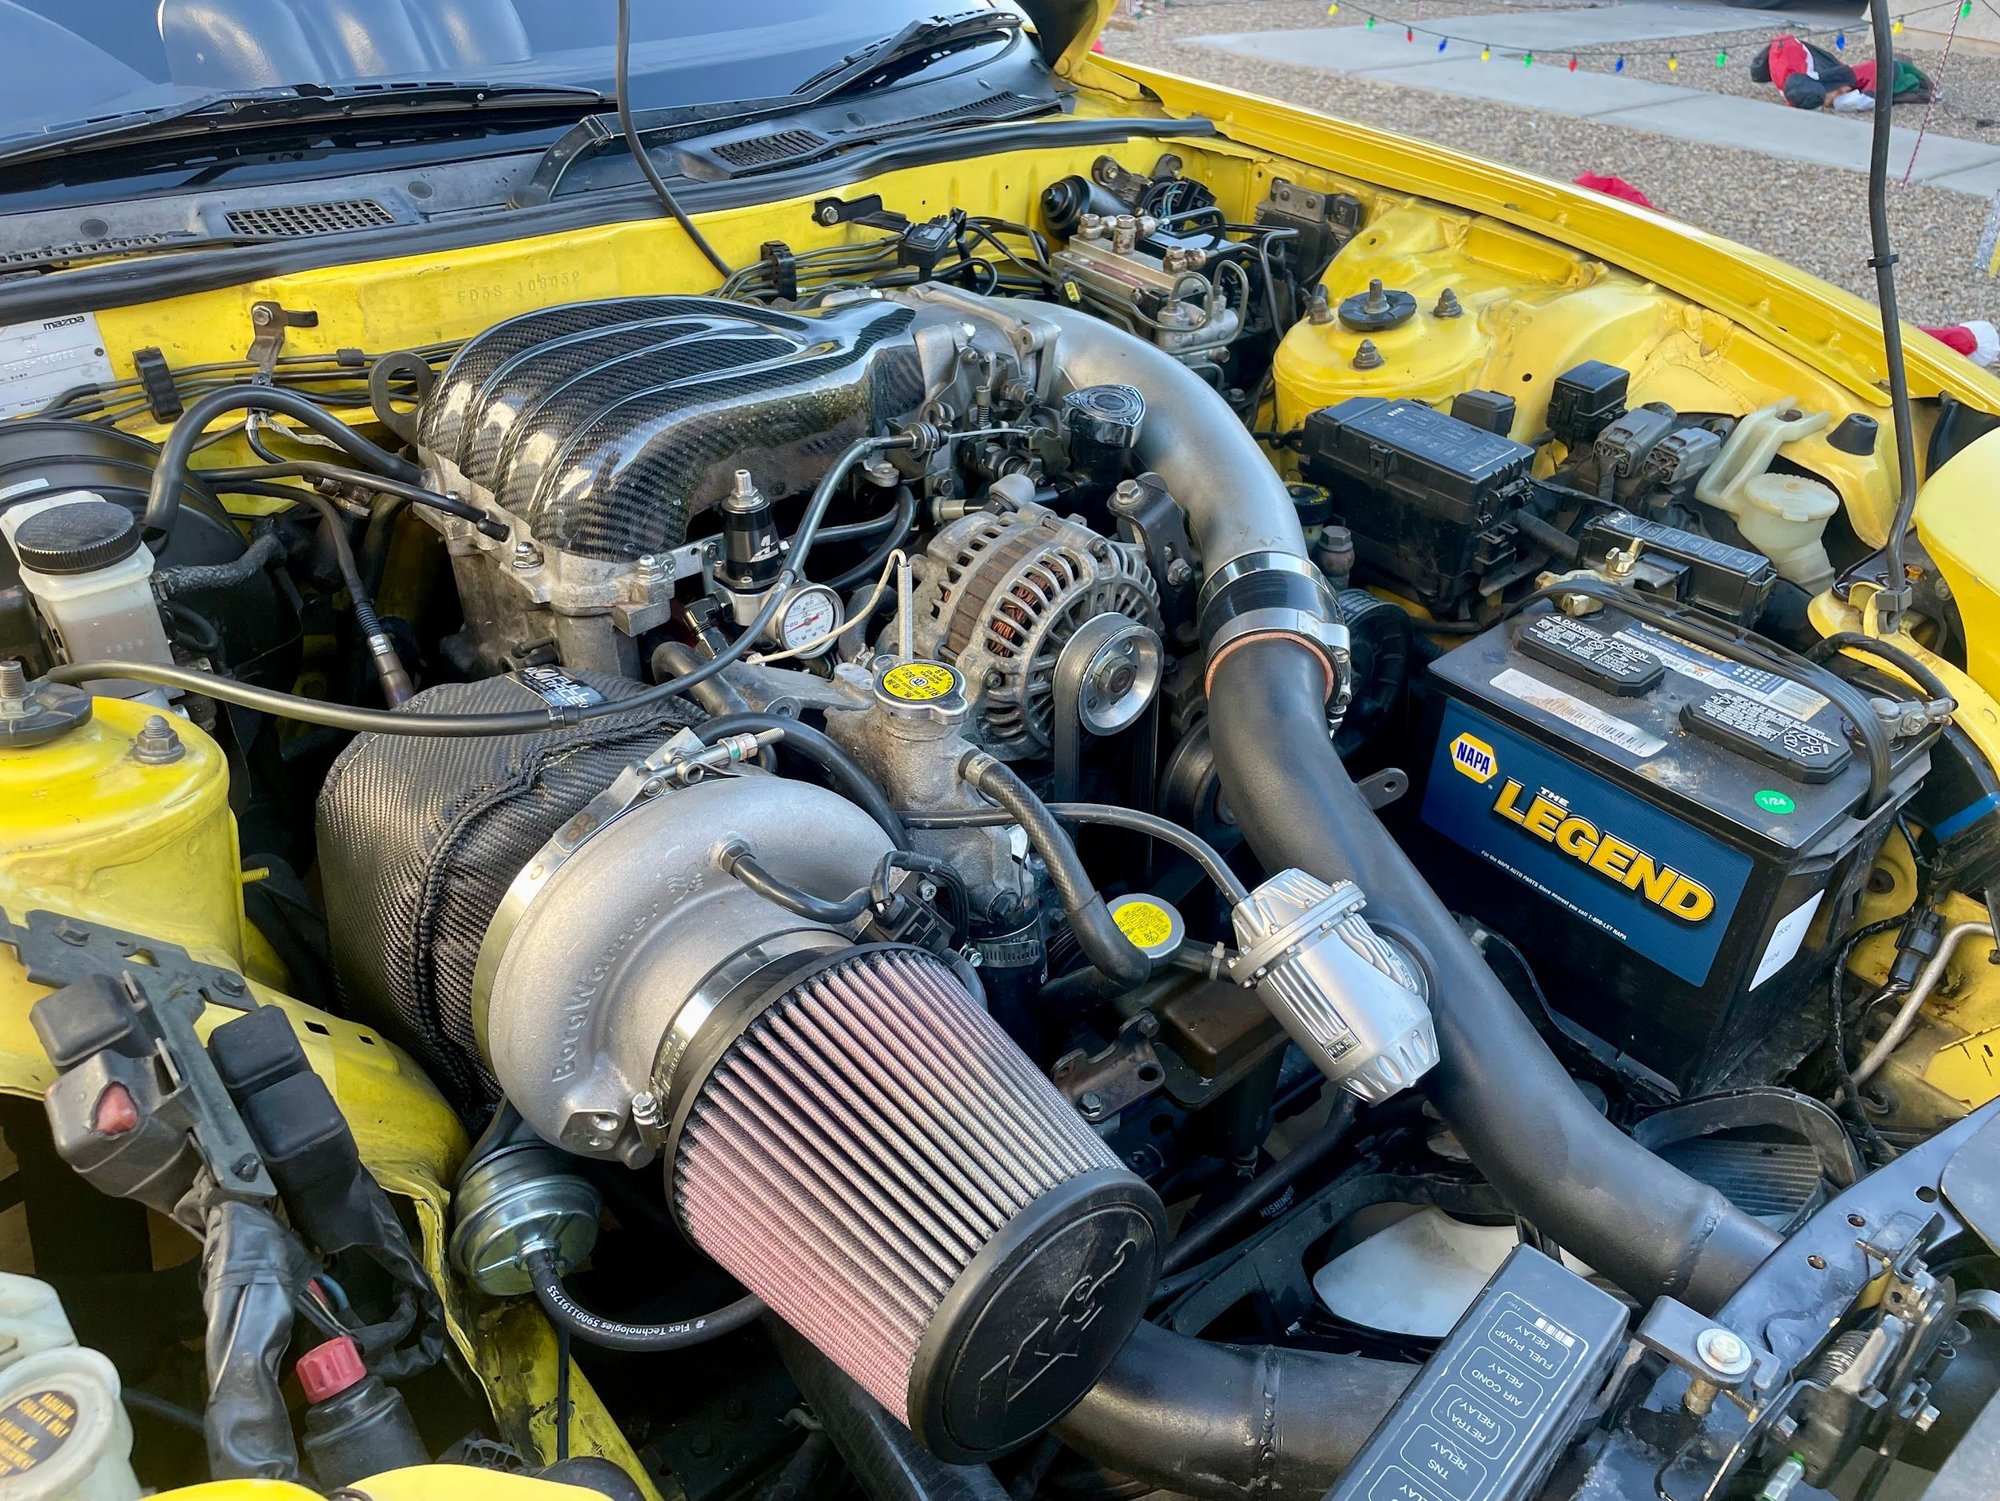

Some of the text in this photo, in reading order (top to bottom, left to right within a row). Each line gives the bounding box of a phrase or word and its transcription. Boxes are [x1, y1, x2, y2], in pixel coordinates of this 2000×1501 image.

[43, 315, 85, 330] mazda
[1561, 619, 1603, 640] DANGER
[1610, 641, 1649, 660] POISON
[1456, 741, 1490, 775] NAPA
[1540, 786, 1570, 807] THE
[1493, 777, 1716, 922] LEGEND
[1497, 859, 1510, 870] NAPA
[1509, 867, 1523, 878] AUTO
[1523, 874, 1538, 888] PARTS
[1538, 884, 1551, 895] Store
[1551, 892, 1570, 905] nearest
[1613, 928, 1627, 941] NAPA
[551, 900, 660, 1084] BorgWarner
[546, 1285, 691, 1337] Flex Technologies 59001191755
[1494, 1329, 1554, 1372] FUEL PUMP
[1515, 1324, 1550, 1350] RELAY
[1471, 1369, 1523, 1407] AIR COND
[1488, 1362, 1524, 1389] RELAY
[1428, 1459, 1449, 1480] TNS
[1431, 1442, 1468, 1471] RELAY
